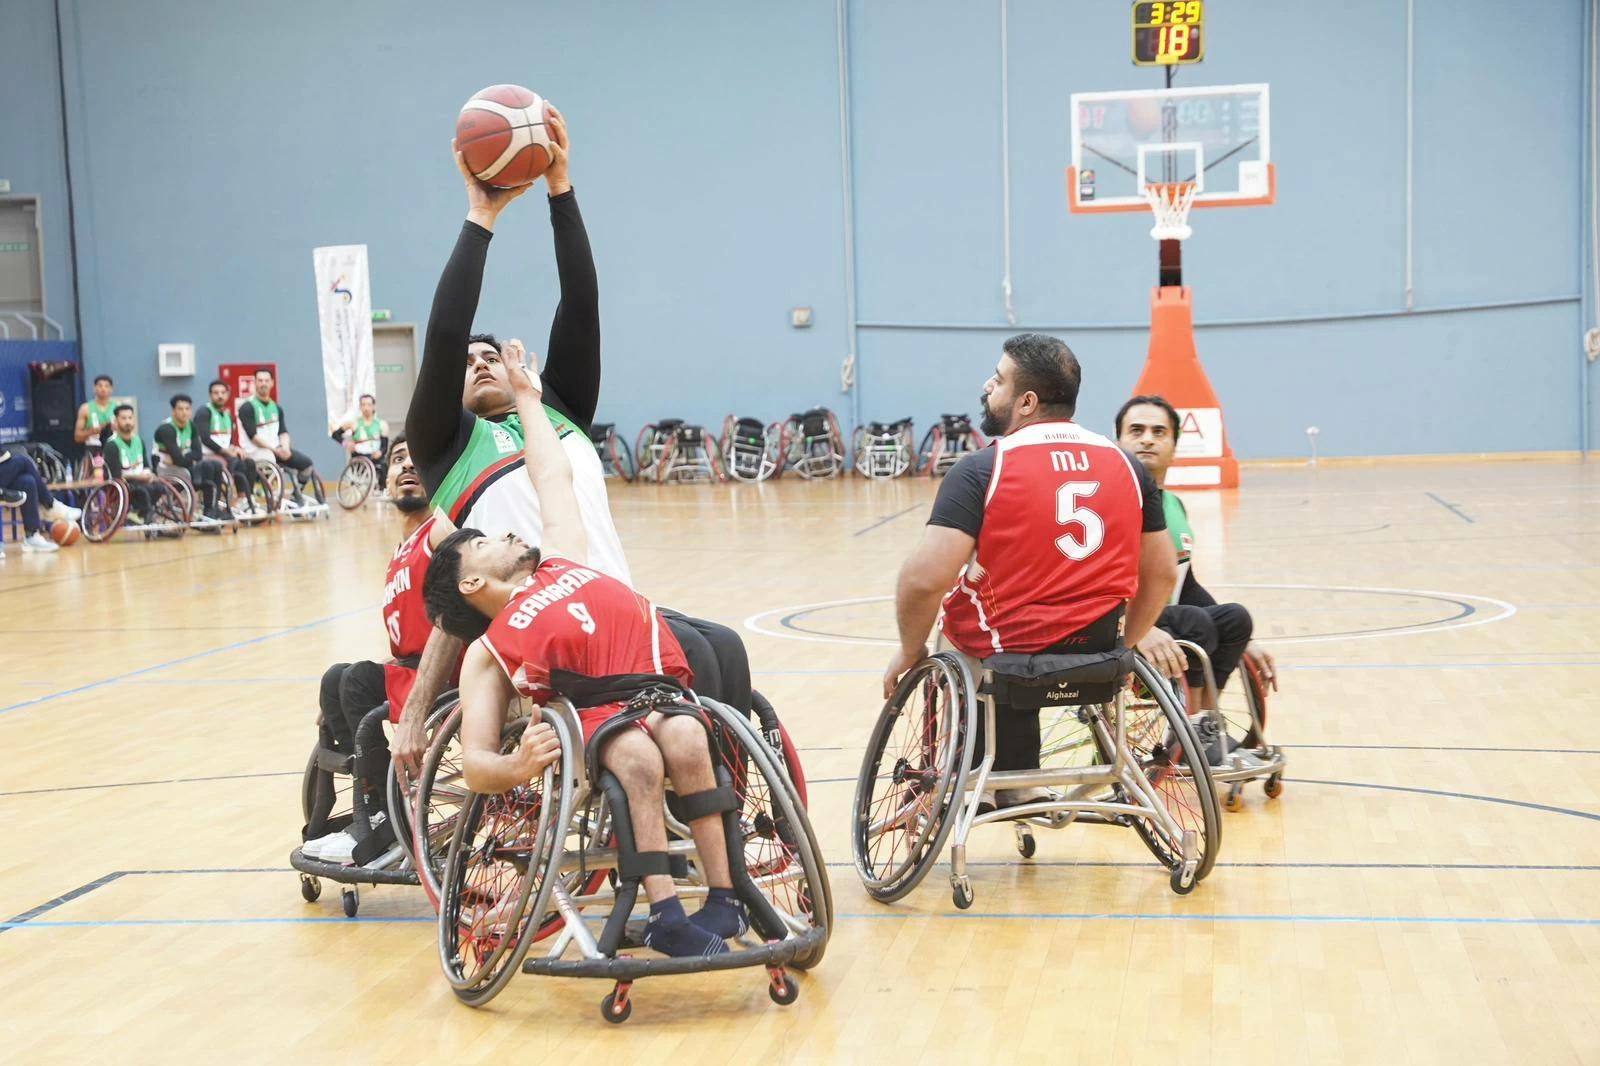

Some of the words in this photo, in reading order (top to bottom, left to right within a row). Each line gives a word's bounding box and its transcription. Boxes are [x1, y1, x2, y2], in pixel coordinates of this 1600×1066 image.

[1150, 1, 1200, 24] 3:29
[1158, 24, 1189, 56] 18
[1049, 450, 1090, 472] MJ
[1055, 480, 1105, 562] 5
[507, 567, 601, 630] BAHRAIN
[566, 602, 596, 635] 9
[1046, 689, 1080, 701] Alghazal
